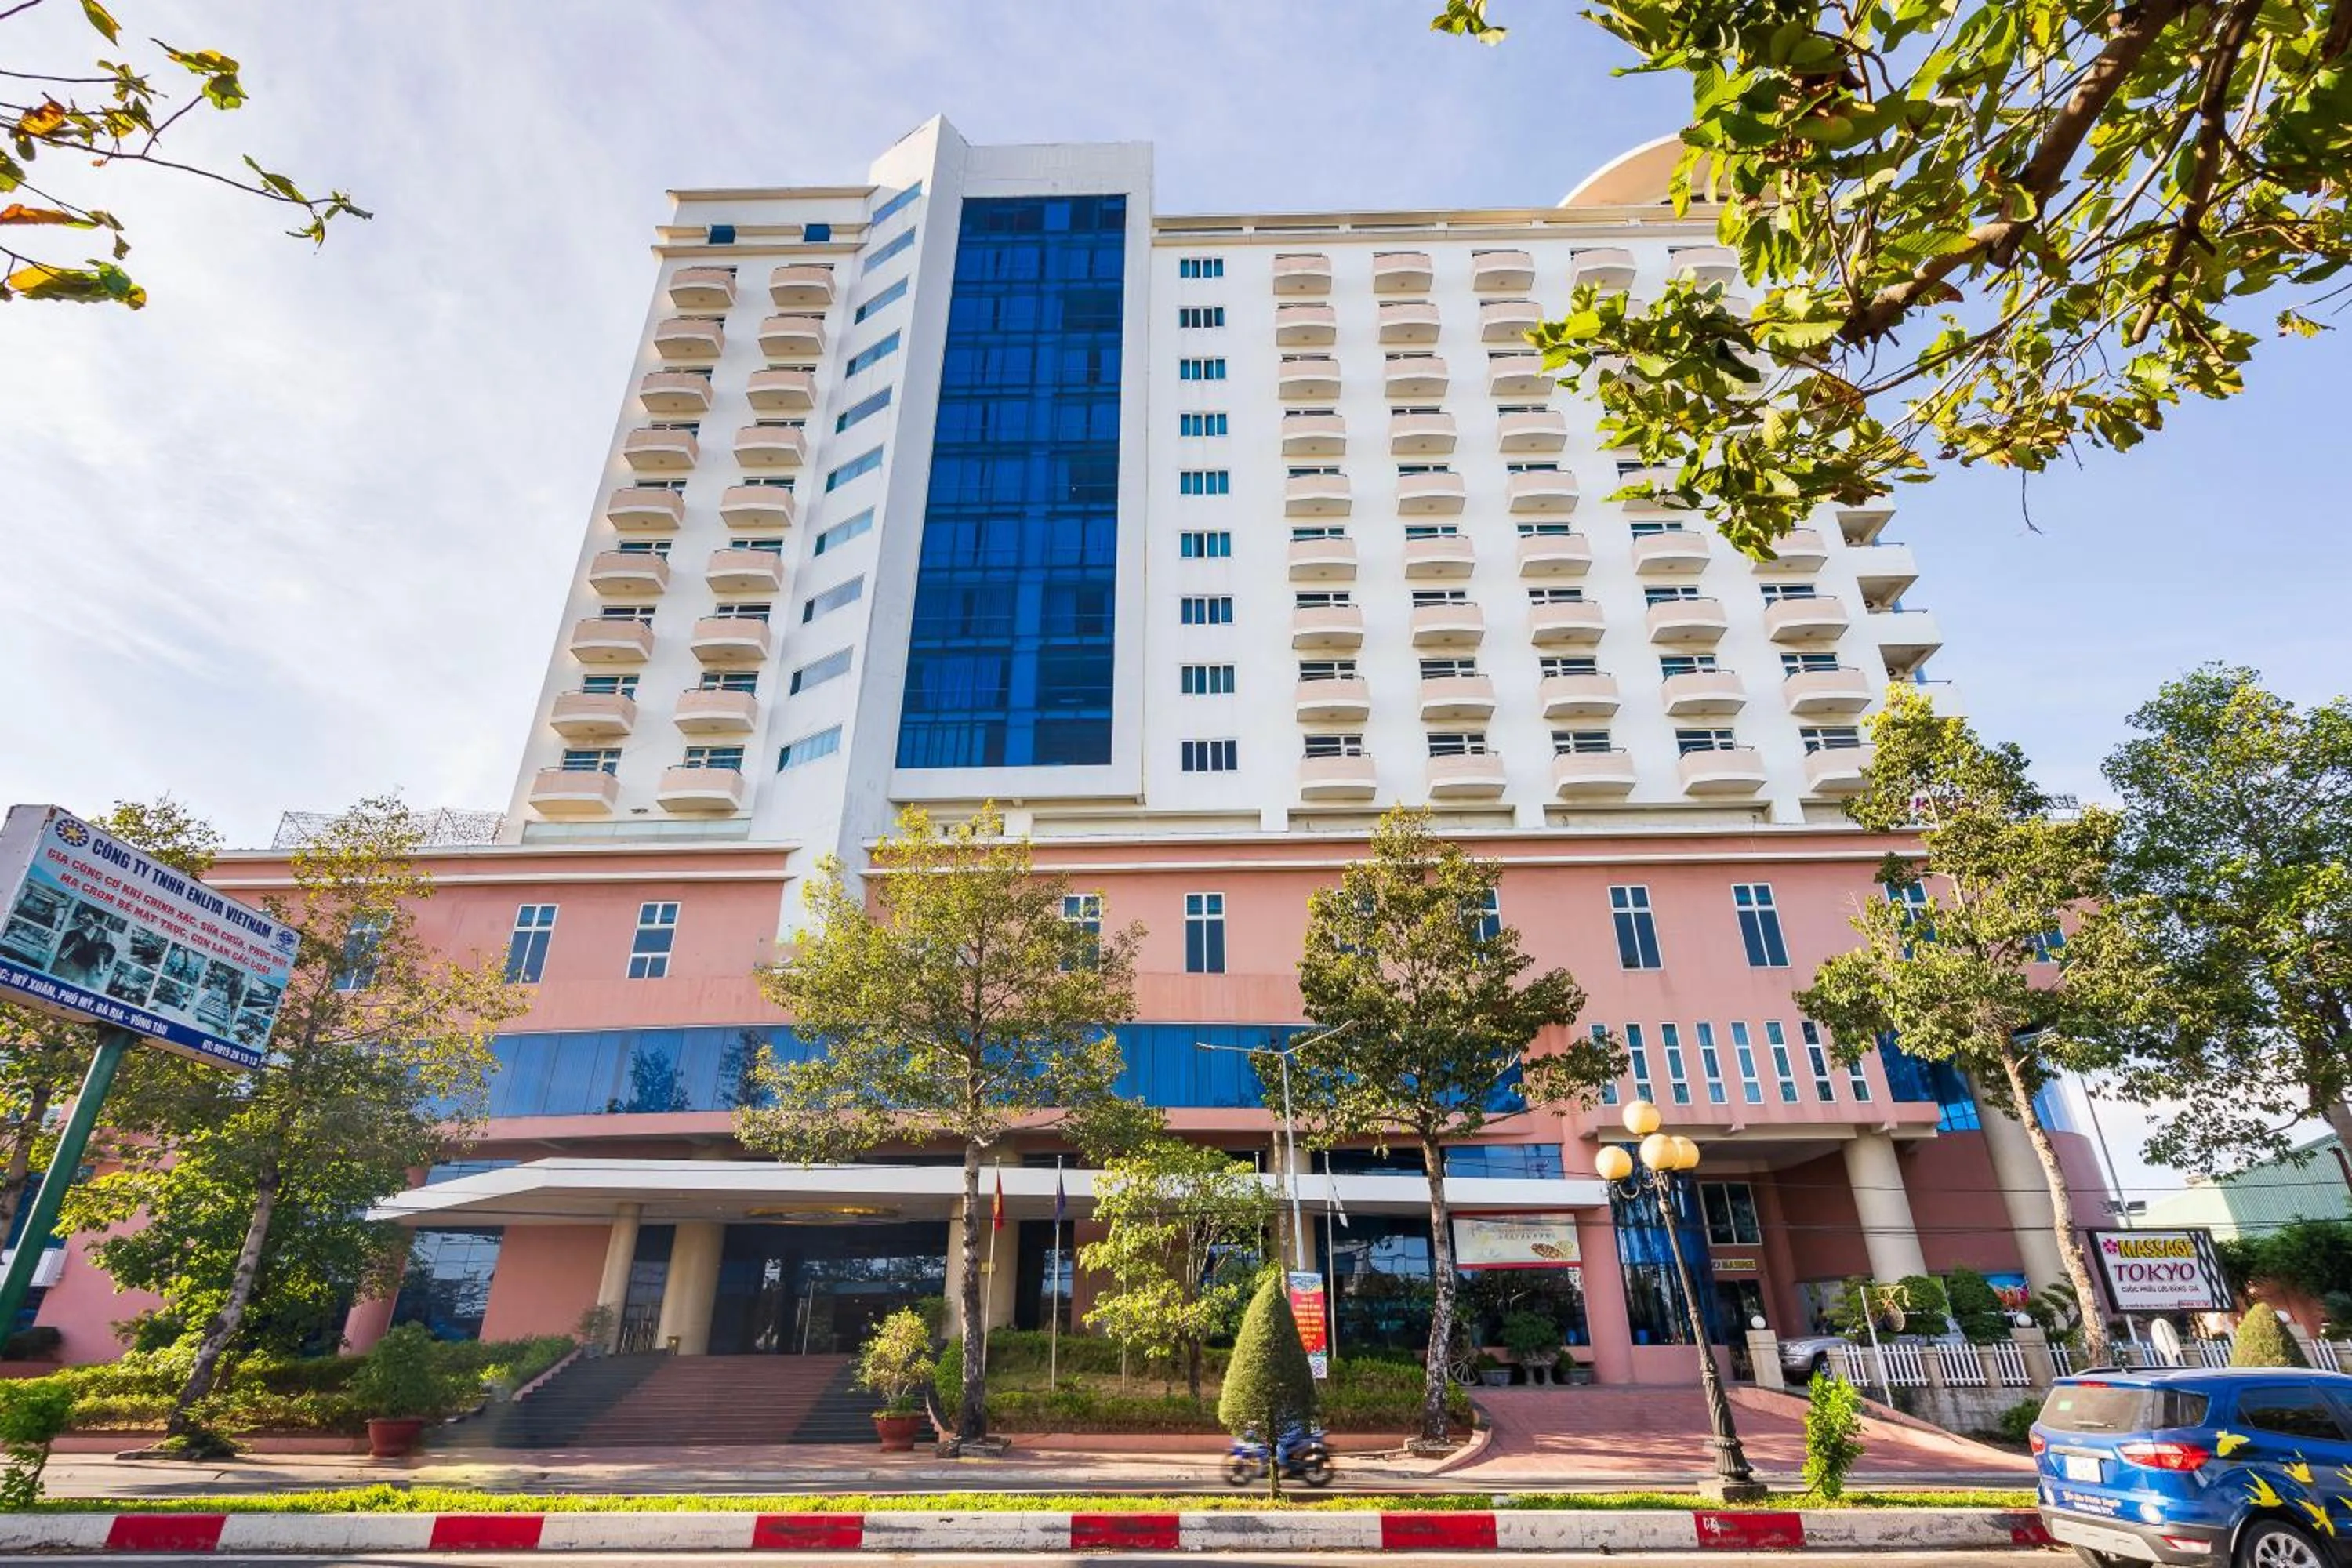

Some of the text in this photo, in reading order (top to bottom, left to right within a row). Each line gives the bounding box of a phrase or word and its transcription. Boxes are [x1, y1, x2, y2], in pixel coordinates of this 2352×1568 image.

[92, 838, 131, 869] CÔNG
[133, 858, 151, 878] TY
[152, 868, 186, 896] TNHH
[225, 906, 272, 939] VIETNAM
[2117, 1239, 2195, 1258] MASSAGE
[2113, 1263, 2195, 1282] TOKYO
